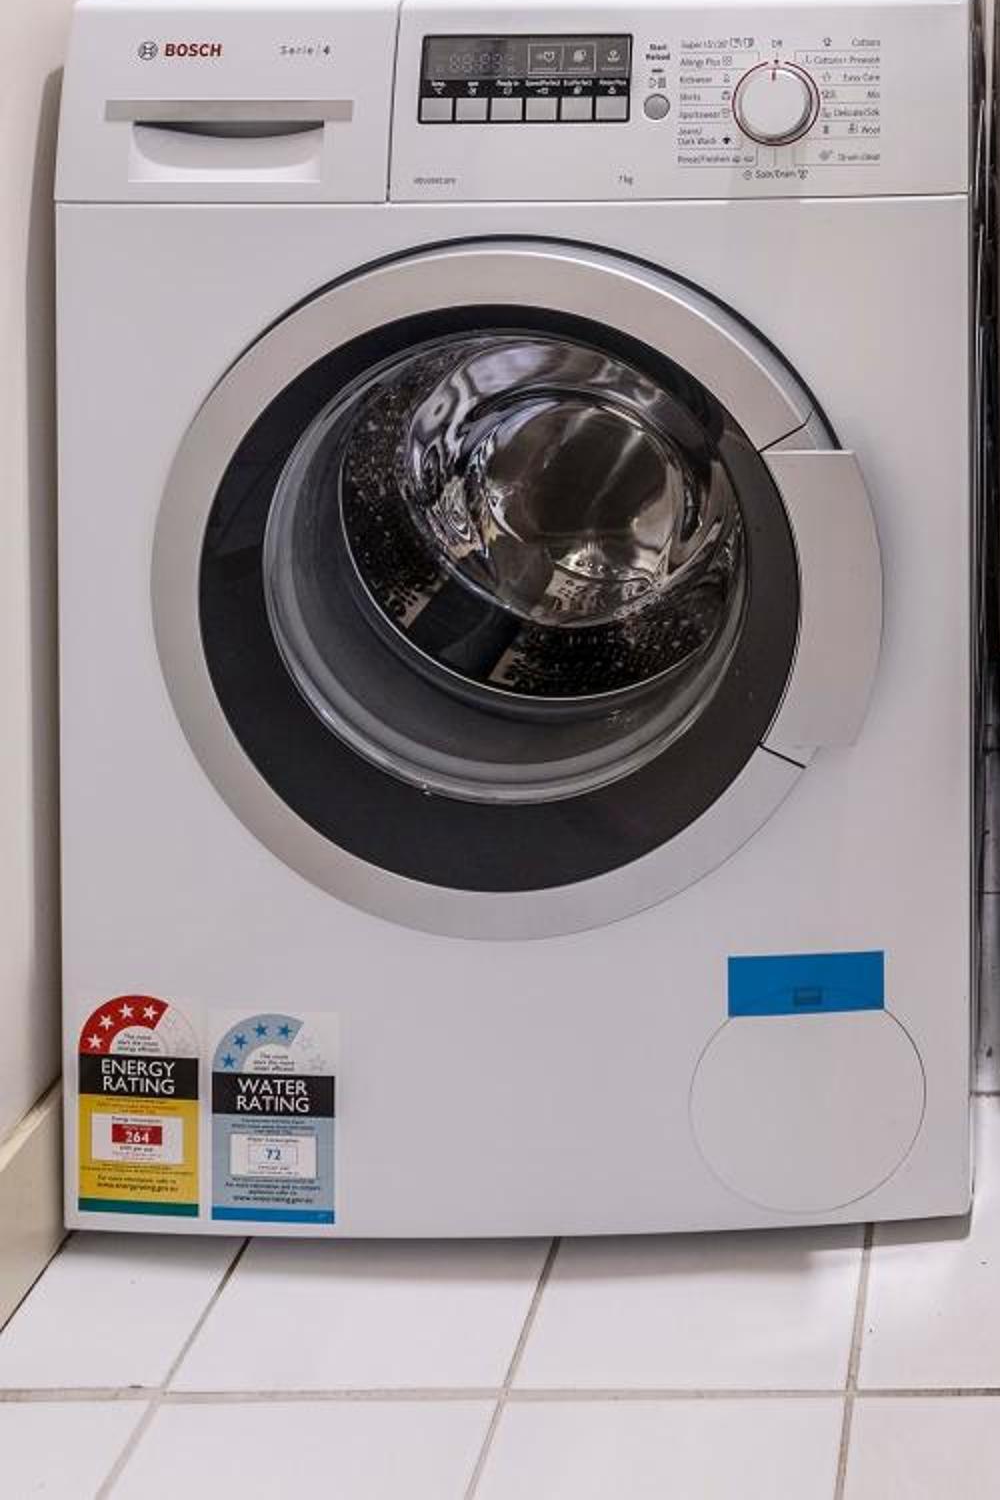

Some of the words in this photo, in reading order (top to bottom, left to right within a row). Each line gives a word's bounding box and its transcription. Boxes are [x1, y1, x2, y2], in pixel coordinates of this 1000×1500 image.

[165, 43, 222, 57] BOSCH
[101, 1059, 176, 1077] ENERGY
[102, 1075, 176, 1095] RATING
[237, 1077, 308, 1096] WATER
[236, 1095, 310, 1113] RATING
[125, 1131, 149, 1143] 264
[265, 1148, 281, 1161] 72
